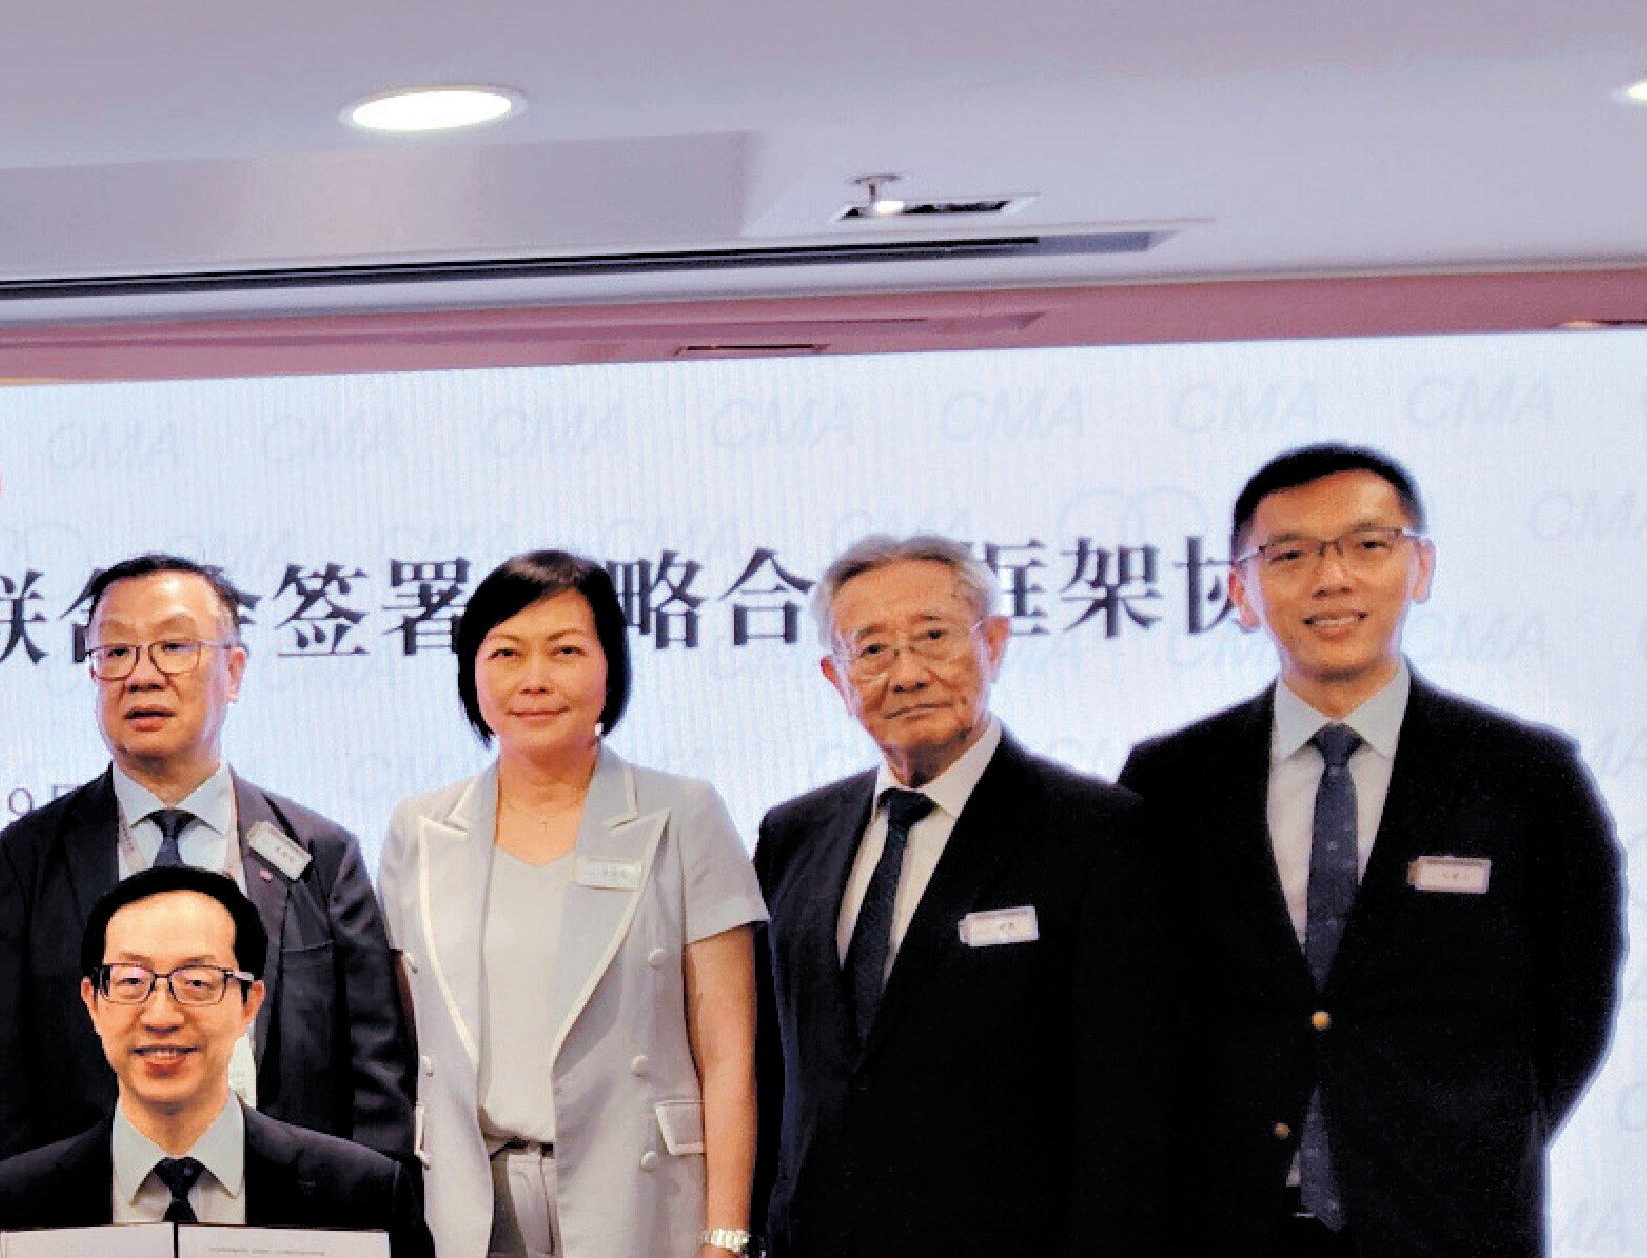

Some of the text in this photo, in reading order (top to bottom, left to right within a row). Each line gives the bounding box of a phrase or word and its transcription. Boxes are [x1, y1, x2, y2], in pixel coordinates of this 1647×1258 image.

[710, 397, 855, 451] CMA
[939, 386, 1086, 442] CMA
[1171, 379, 1321, 436] CMA
[1404, 373, 1555, 429] CMA
[45, 421, 182, 473] CMA
[260, 411, 403, 464] CMA
[480, 403, 627, 458] CMA
